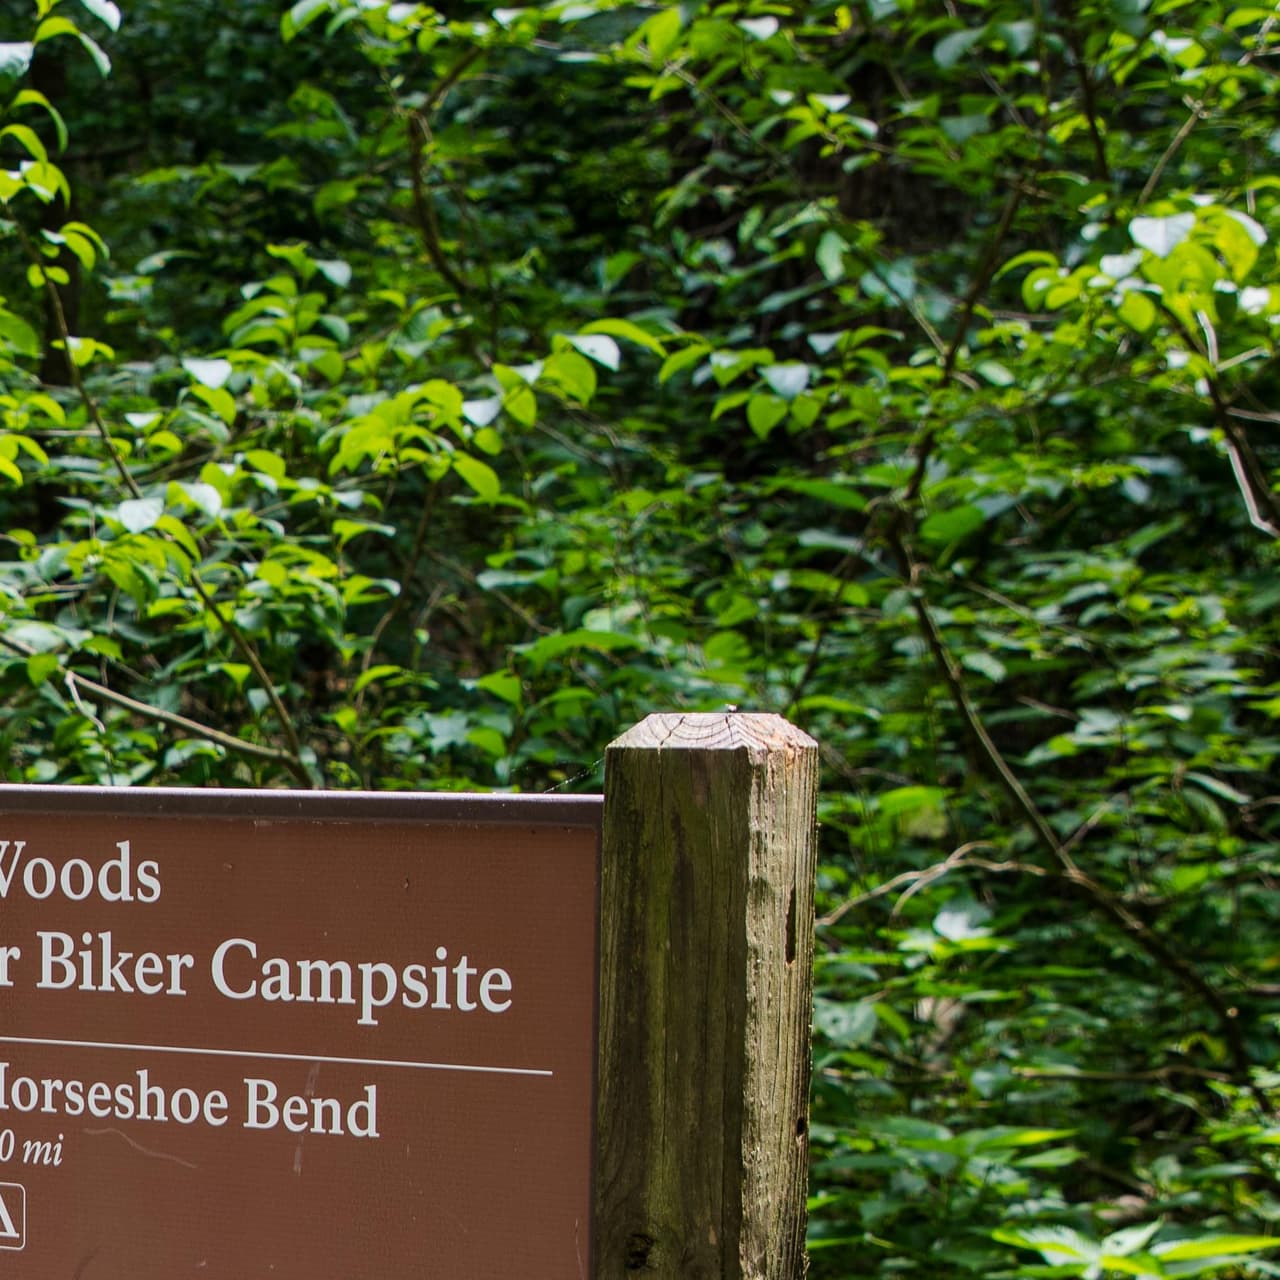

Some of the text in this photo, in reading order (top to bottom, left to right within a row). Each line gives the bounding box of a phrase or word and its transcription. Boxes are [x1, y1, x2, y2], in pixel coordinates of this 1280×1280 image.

[36, 931, 195, 996] Biker
[211, 938, 513, 1026] Campsite
[243, 1078, 381, 1139] Bend
[21, 1133, 65, 1167] mi
